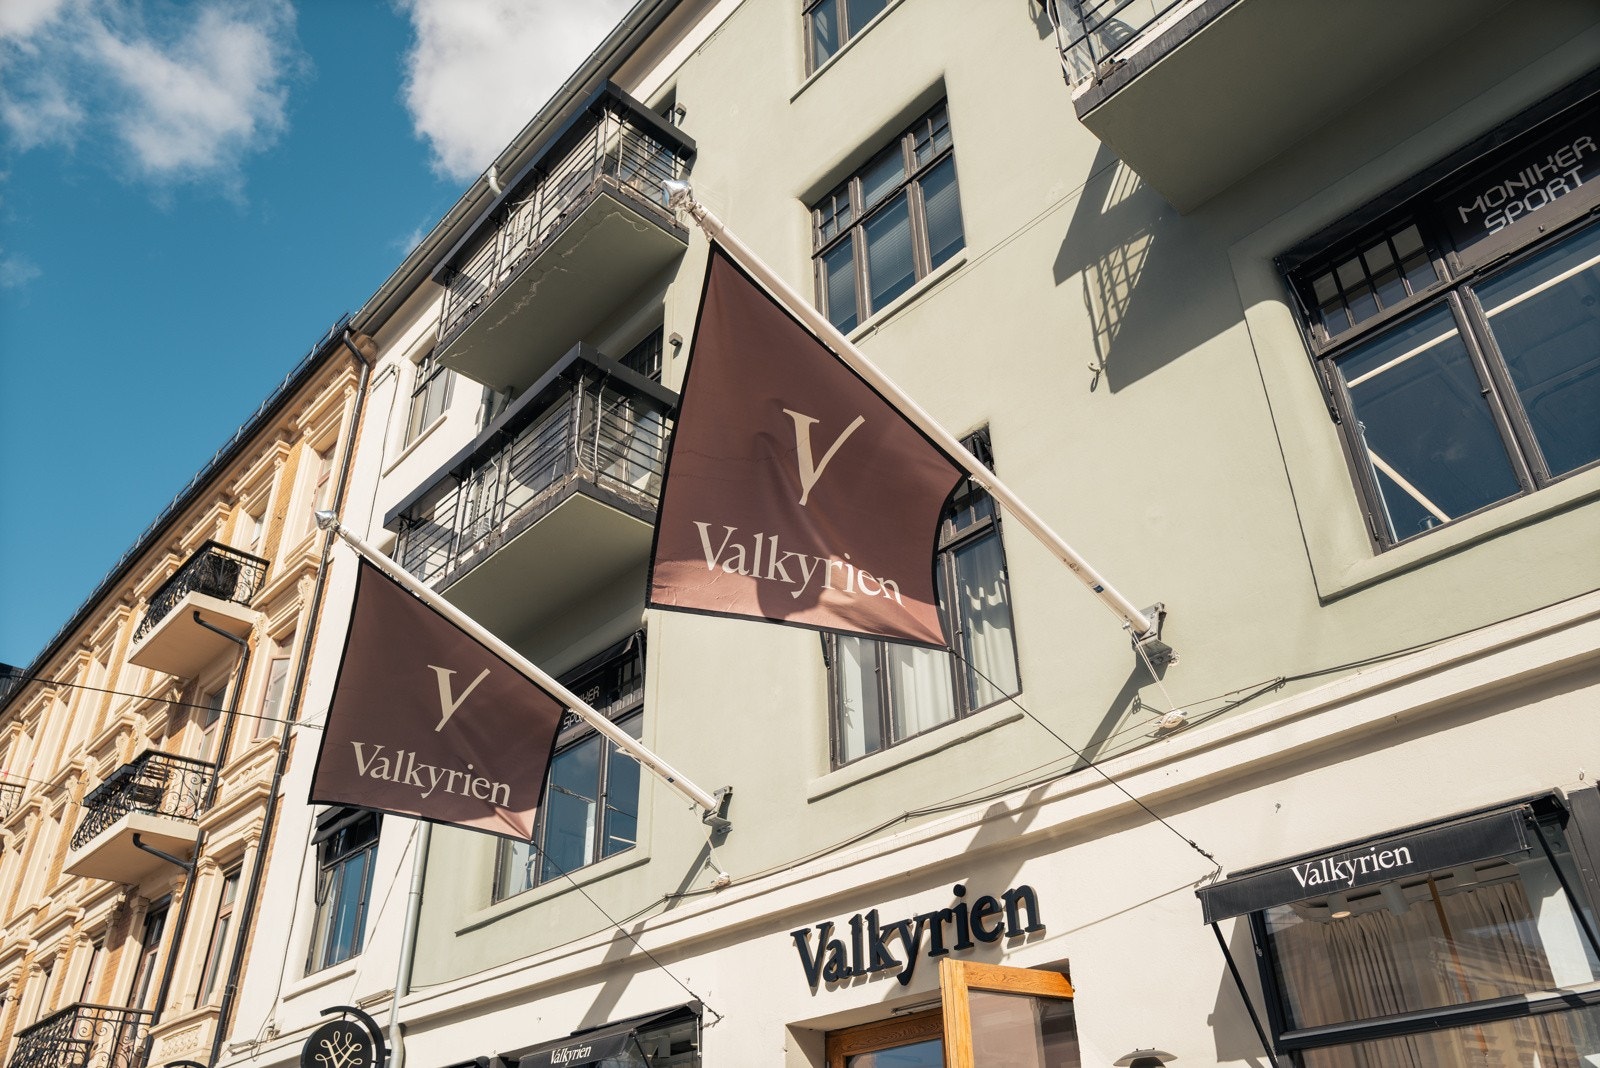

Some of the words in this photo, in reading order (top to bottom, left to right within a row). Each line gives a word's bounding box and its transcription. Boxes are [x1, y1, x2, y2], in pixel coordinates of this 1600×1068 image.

[1458, 136, 1597, 224] MONIKER
[1484, 164, 1583, 235] SPORT
[692, 520, 906, 608] Valkyrien
[350, 741, 511, 808] Valkyrien
[1290, 846, 1414, 887] Valkyrien
[790, 884, 1046, 987] Valkyrien
[550, 1044, 592, 1066] Valkyrien
